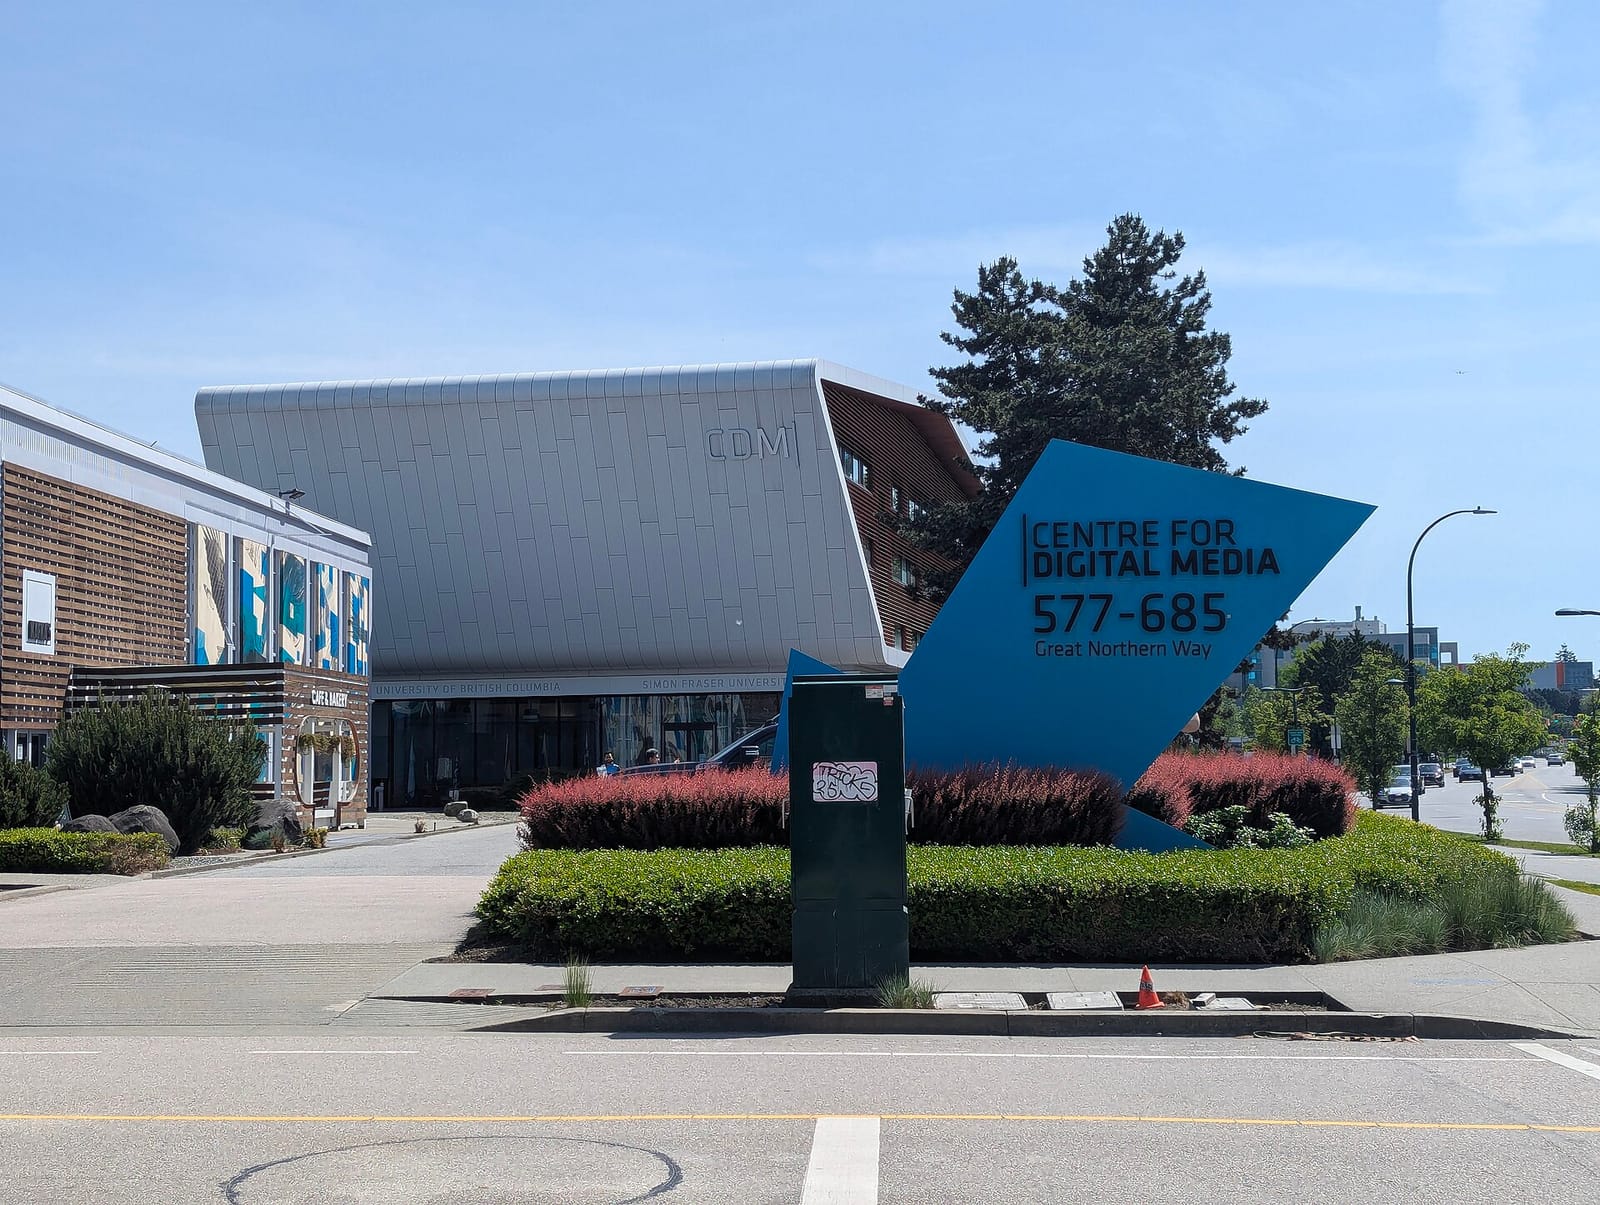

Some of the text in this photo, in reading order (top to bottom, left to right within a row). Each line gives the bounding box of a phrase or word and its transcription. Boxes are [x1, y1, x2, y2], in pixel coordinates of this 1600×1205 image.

[705, 427, 790, 461] CDM
[1033, 519, 1237, 548] CENTRE FOR
[1033, 548, 1281, 578] DIGITAL MEDIA
[1033, 592, 1227, 634] 577-685
[1034, 640, 1212, 660] Great Northern Way
[376, 681, 561, 695] UNIVERSITY OF BRITISH COLUMBIA
[642, 676, 786, 690] SIMON FRASER UNIVERSIT
[311, 689, 324, 706] CAFE
[329, 691, 348, 708] BAKERY
